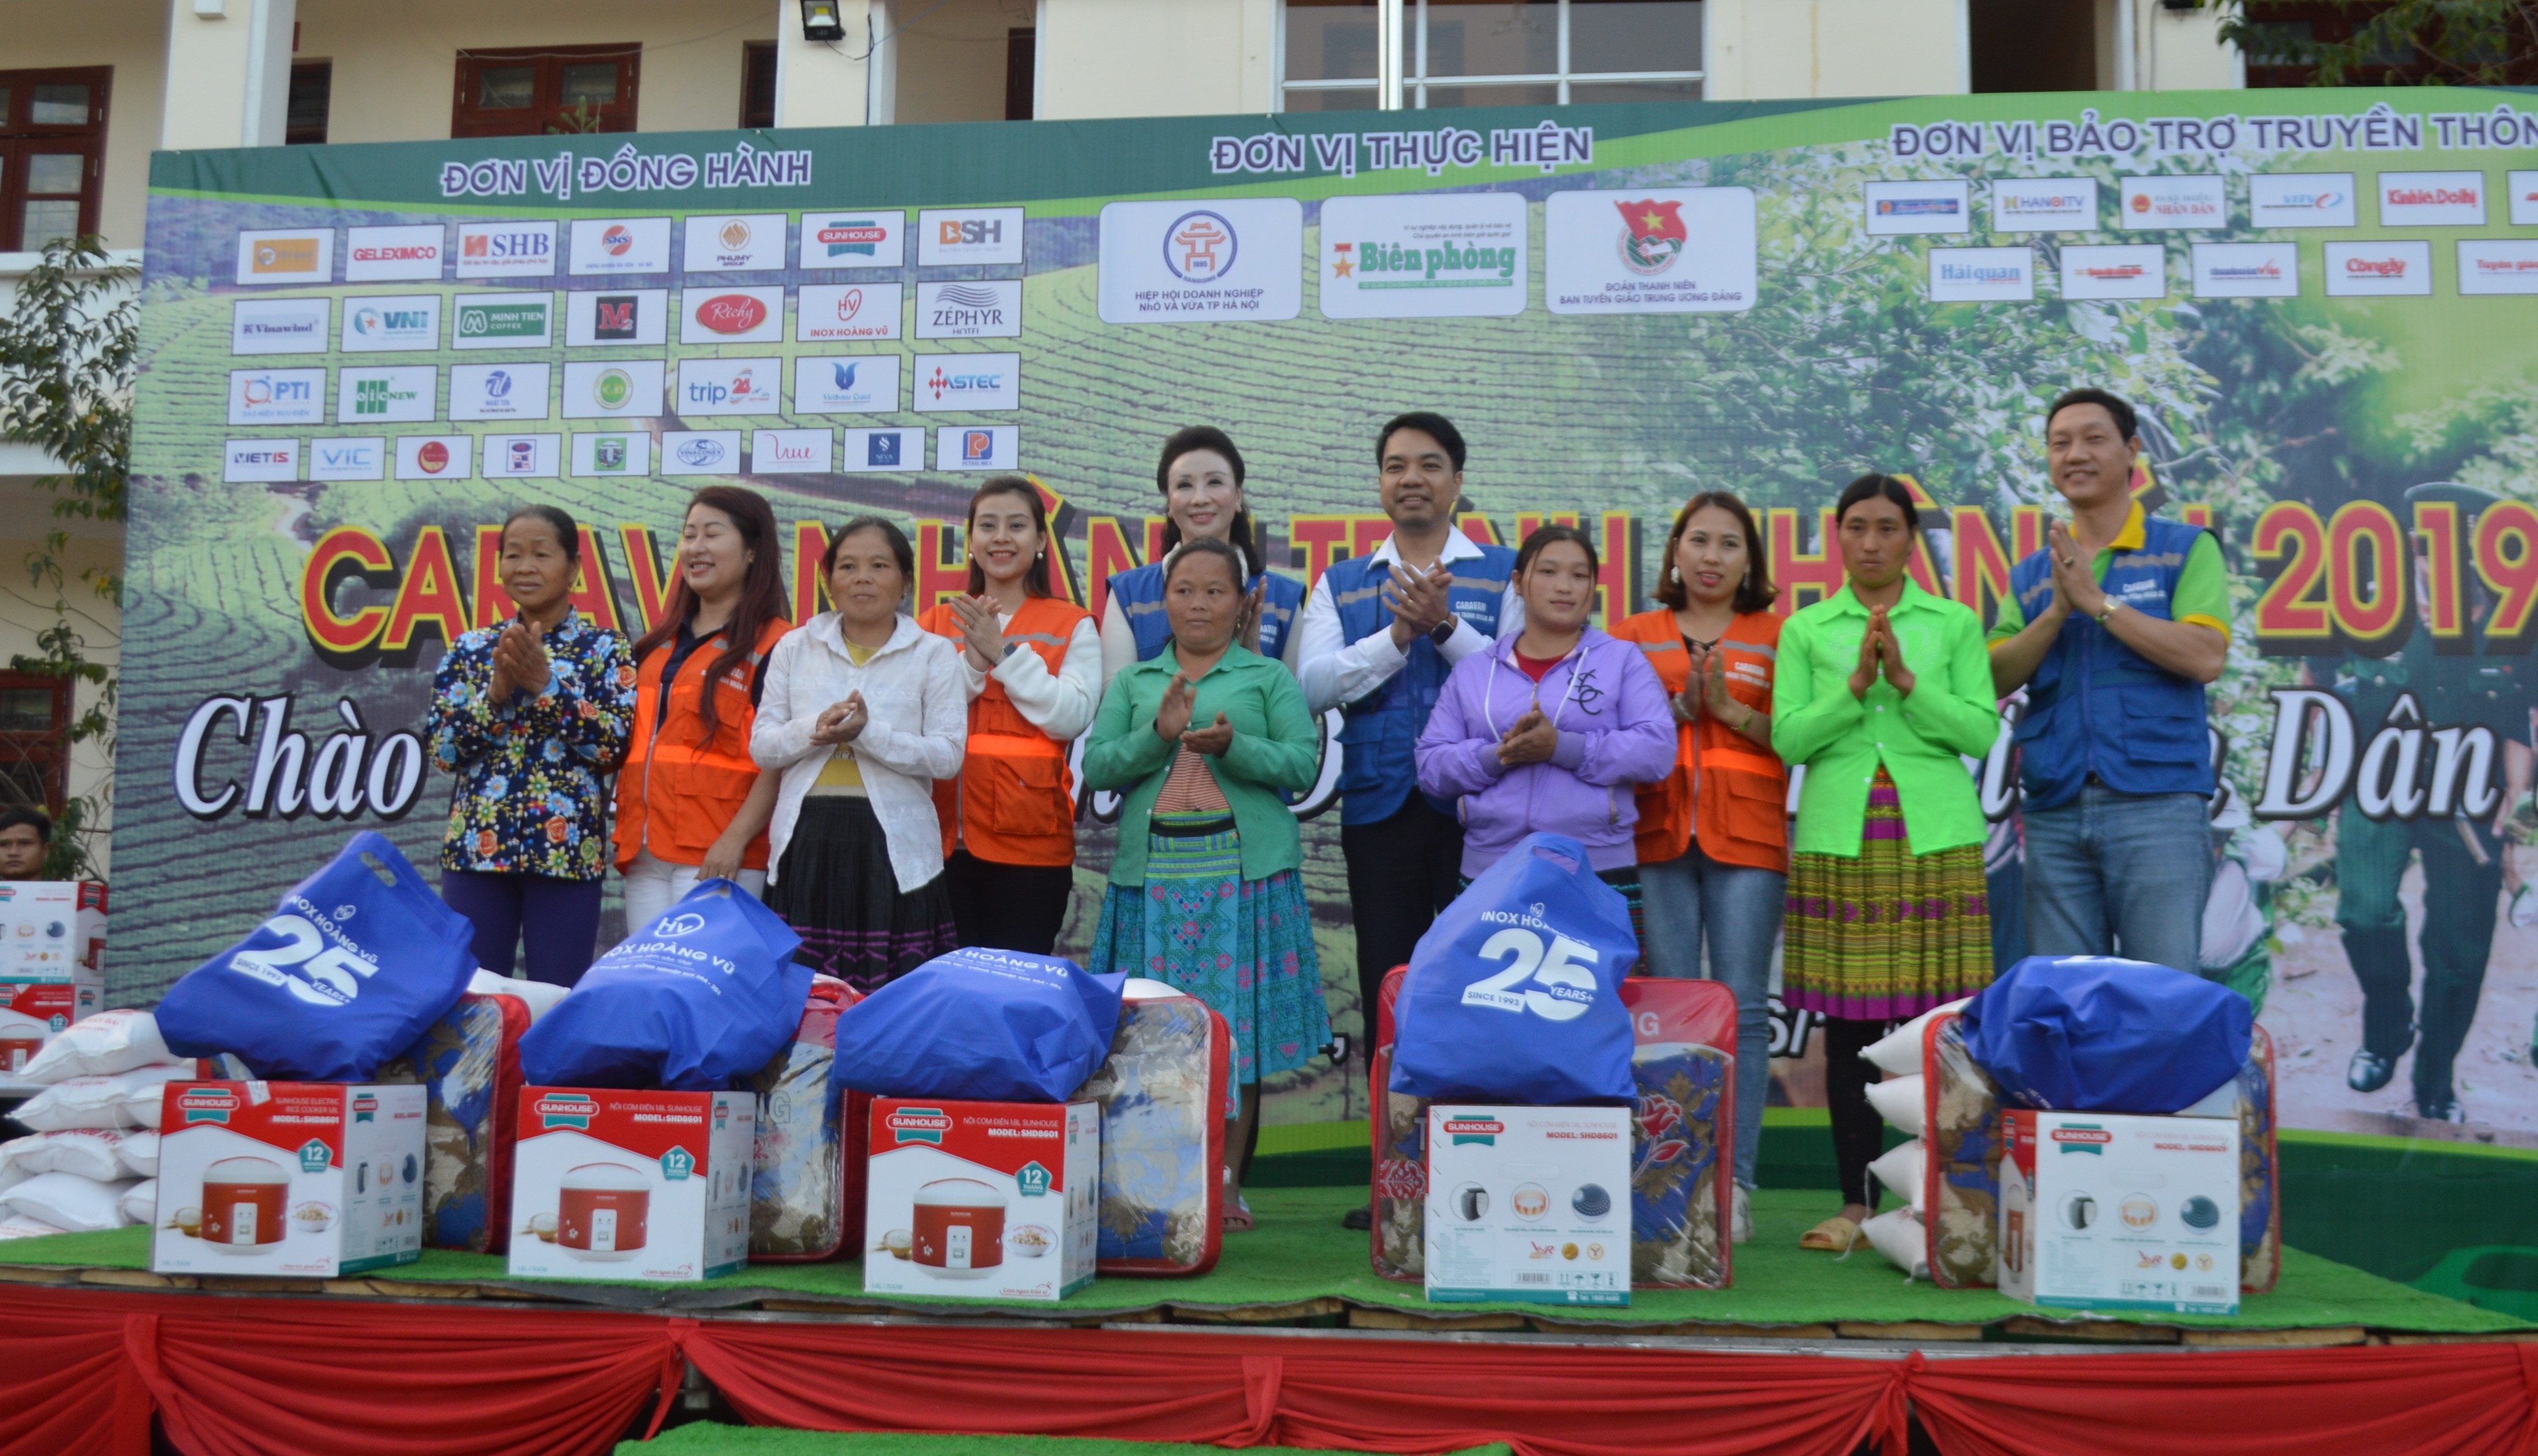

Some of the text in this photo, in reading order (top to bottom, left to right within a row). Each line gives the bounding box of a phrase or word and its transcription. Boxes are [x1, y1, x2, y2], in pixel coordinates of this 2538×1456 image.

[1891, 119, 1985, 158] ĐƠN
[1990, 121, 2035, 163] VỊ
[2044, 108, 2138, 155] BẢO
[2147, 114, 2237, 158] TRỢ
[2248, 102, 2421, 149] TRUYỀN
[1210, 120, 1593, 178] ĐƠN VỊ THỰC HIỆN
[441, 140, 812, 200] ĐƠN VỊ ĐỒNG HÀNH
[823, 231, 881, 241] SUNHOUSE
[939, 219, 1002, 245] BSH
[491, 232, 549, 257] SHB
[353, 246, 437, 262] GELEXIMCO
[1359, 240, 1516, 279] Biên phòng
[1606, 279, 1696, 291] ĐOÀN THANH NIÊN
[1135, 288, 1264, 302] HIỆP HỘI DOANH NGHIỆP
[1560, 295, 1580, 304] BAN
[1583, 292, 1611, 303] TUYÊN
[1615, 291, 1641, 303] GIÁO
[1645, 293, 1675, 303] TRUNG
[1712, 289, 1741, 301] ĐẢNG
[1164, 299, 1179, 310] VÀ
[1181, 299, 1204, 310] VỪA
[1207, 301, 1220, 310] TP
[1223, 298, 1238, 310] HÀ
[1241, 298, 1259, 310] NỘI
[383, 311, 428, 329] VNI
[491, 312, 544, 321] MINH TIEN
[711, 298, 754, 329] Richy
[257, 323, 313, 334] Vinawind
[810, 325, 888, 337] INOX HOÀNG VŨ
[275, 381, 310, 400] PTI
[388, 392, 417, 400] NEW
[689, 381, 727, 405] trip
[322, 448, 372, 465] VIC
[2252, 500, 2538, 650] 2019
[1455, 600, 1487, 611] CARAVAN
[172, 688, 2505, 822] Chào Dân
[660, 916, 694, 933] HV
[1481, 910, 1518, 925] INOX
[315, 913, 379, 964] HOÀNG VŨ
[637, 941, 708, 960] HOÀNG
[229, 914, 379, 1006] 25
[965, 950, 1039, 969] HOÀNG
[1461, 928, 1598, 1021] 25
[1468, 991, 1520, 1006] SINCE 1993
[183, 1099, 234, 1107] SUNHOUSE
[540, 1104, 594, 1112] SUNHOUSE
[893, 1118, 946, 1127] SUNHOUSE
[993, 1117, 1009, 1126] ĐIỆN
[1447, 1123, 1500, 1131] SUNHOUSE
[2054, 1131, 2108, 1141] SUNHOUSE
[306, 1146, 325, 1161] 12
[668, 1153, 686, 1168] 12
[1023, 1169, 1043, 1184] 12
